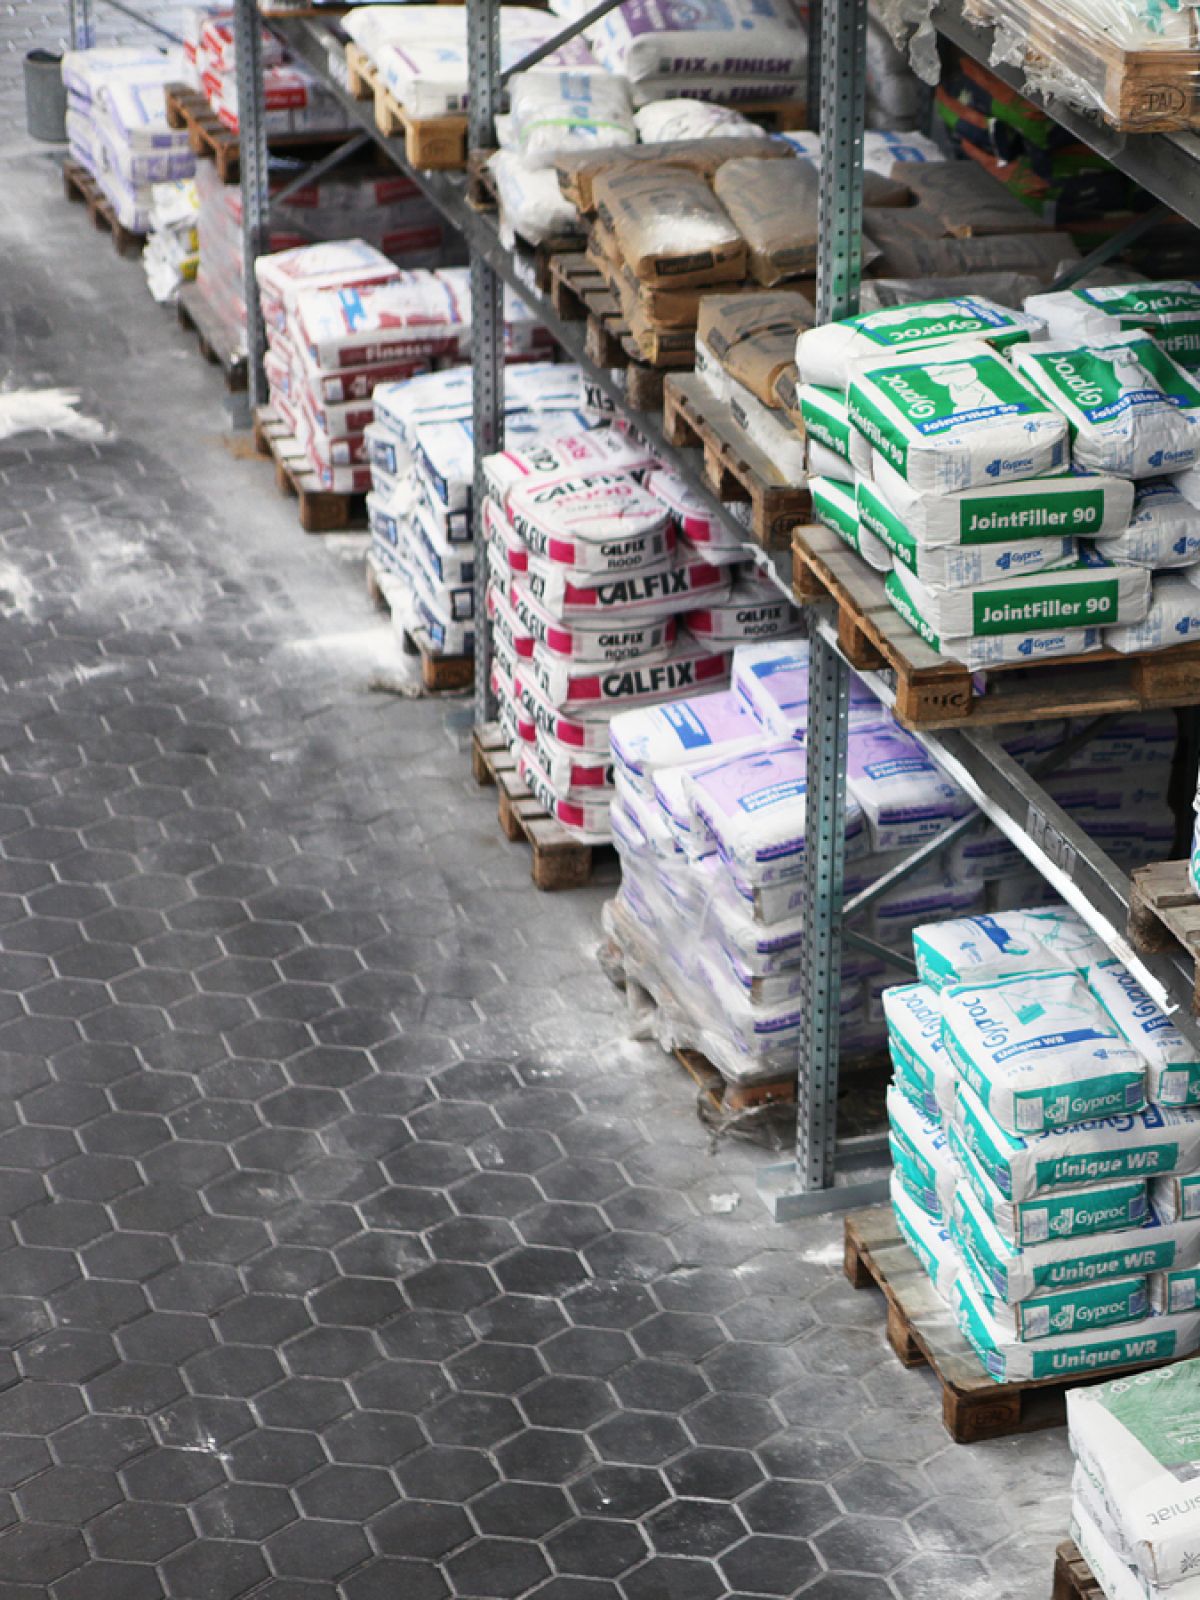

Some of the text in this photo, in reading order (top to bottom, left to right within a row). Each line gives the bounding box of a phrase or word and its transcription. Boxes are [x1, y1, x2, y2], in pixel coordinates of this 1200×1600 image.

[673, 57, 706, 73] FIX
[724, 57, 793, 73] FINISH
[890, 318, 982, 341] Gyproc
[882, 373, 937, 419] Gyproc
[969, 506, 1097, 532] JointFiller 90
[601, 536, 646, 557] CALFIX
[597, 568, 689, 605] CALFIX
[735, 606, 782, 624] CALFIX
[982, 596, 1111, 624] JointFiller 90
[598, 632, 644, 650] CALFIX
[602, 661, 693, 698] CALFIX
[962, 997, 1009, 1047] Gyproc
[1071, 1090, 1122, 1114] Gyproc
[1055, 1150, 1159, 1178] Unique WR
[1075, 1204, 1126, 1228] Gyproc
[1051, 1249, 1157, 1282] Unique WR
[1075, 1299, 1127, 1322] Gyproc
[1052, 1338, 1158, 1369] Unique WR
